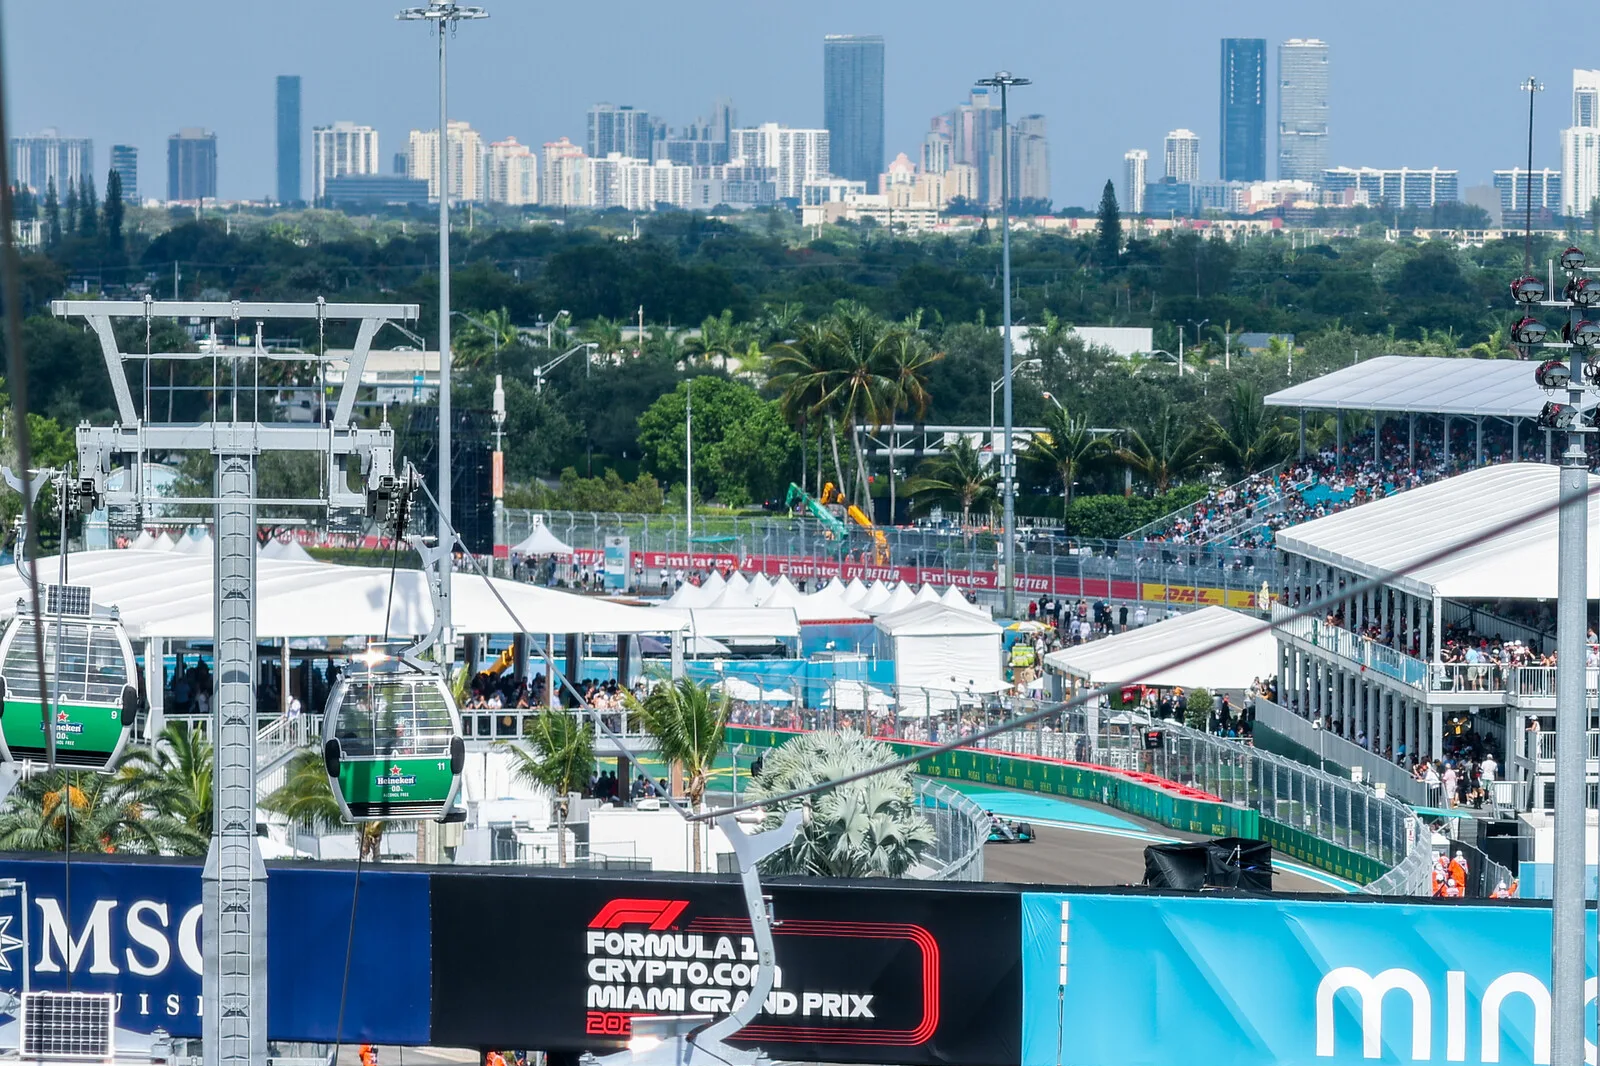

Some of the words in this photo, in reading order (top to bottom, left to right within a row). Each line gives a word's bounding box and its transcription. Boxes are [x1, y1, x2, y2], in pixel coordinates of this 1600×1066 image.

[654, 554, 737, 570] Emirates
[779, 562, 841, 577] Emirates
[847, 567, 862, 578] FLY
[866, 568, 900, 580] BETTER
[921, 571, 988, 586] Emirates
[1164, 587, 1209, 603] DHL
[111, 711, 118, 719] 9
[437, 762, 445, 771] 11
[377, 776, 415, 785] Heineken
[587, 931, 736, 960] FORMULA
[587, 985, 685, 1011] MIAMI
[802, 993, 875, 1018] PRIX
